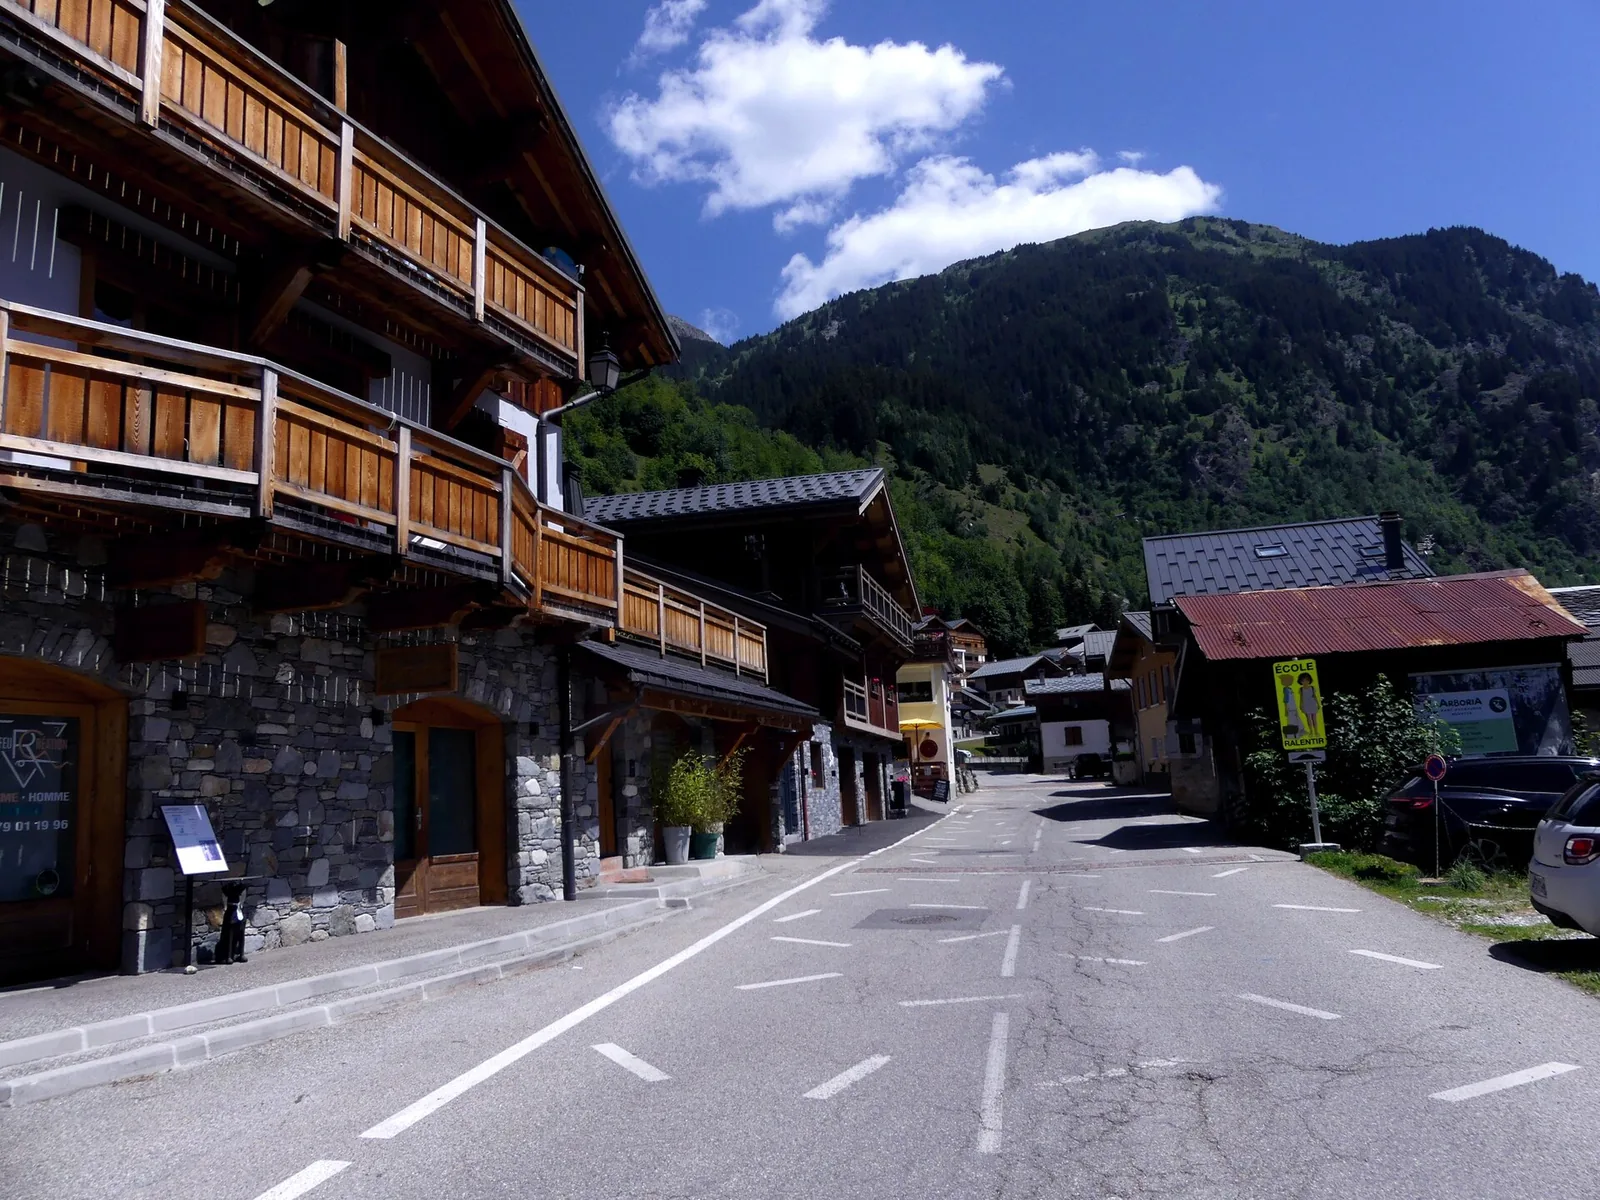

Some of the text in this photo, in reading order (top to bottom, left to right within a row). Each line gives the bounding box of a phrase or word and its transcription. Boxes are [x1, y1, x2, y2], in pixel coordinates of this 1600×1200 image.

[1275, 662, 1314, 674] ÉCOLE
[1284, 737, 1325, 747] RALENTIR
[28, 791, 70, 802] HOMME
[15, 821, 30, 832] 01
[34, 820, 49, 830] 19
[53, 819, 69, 830] 96
